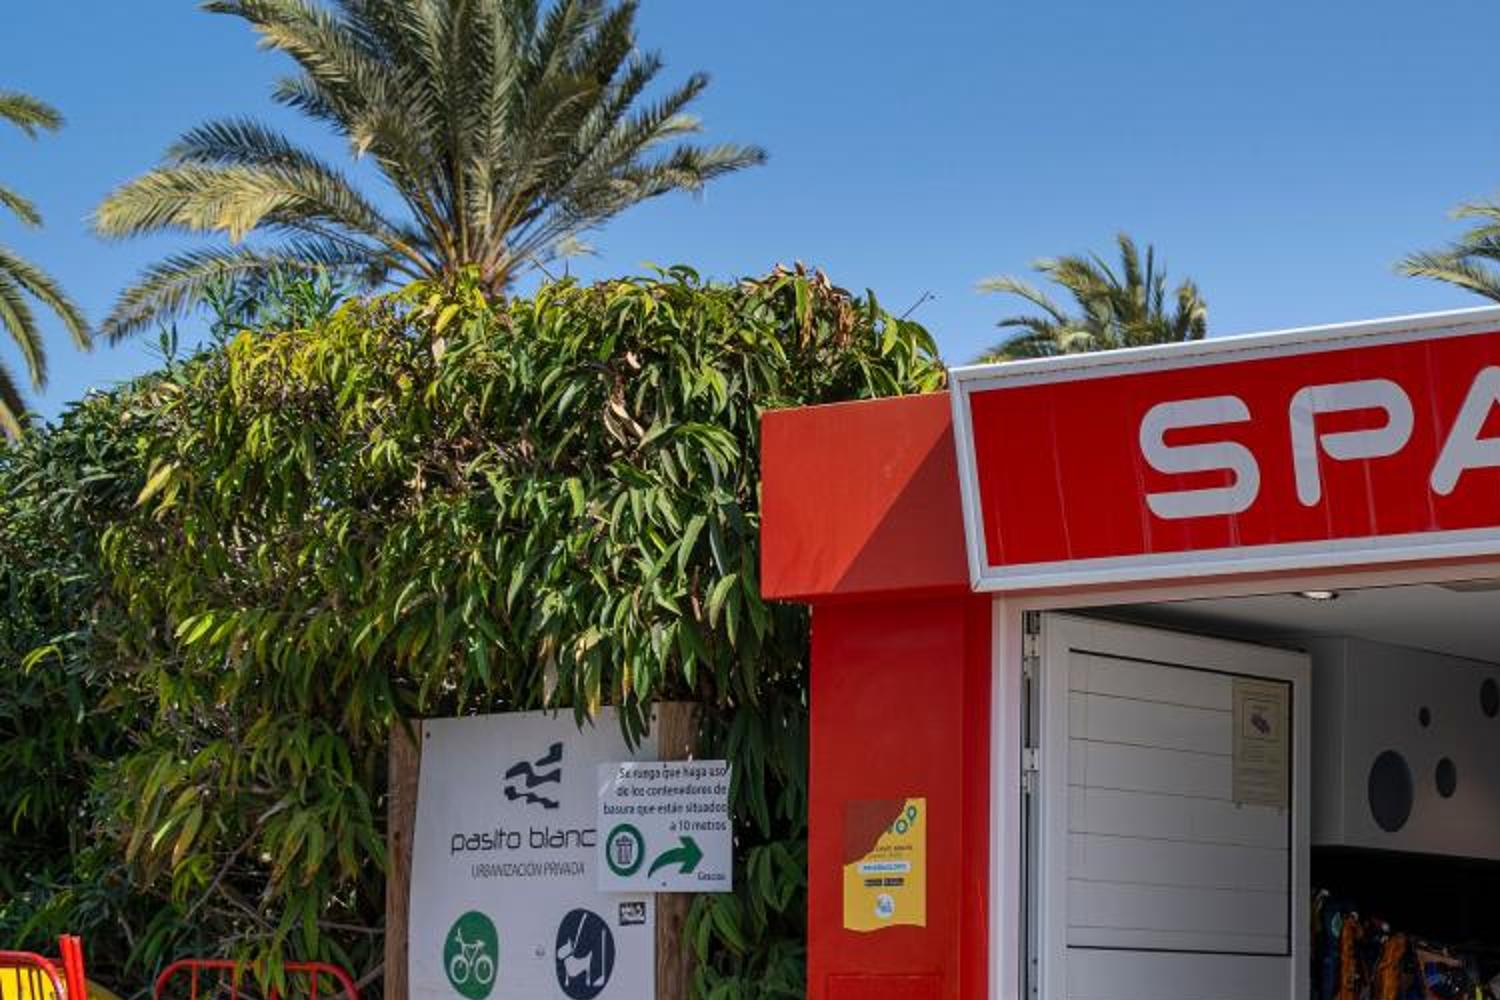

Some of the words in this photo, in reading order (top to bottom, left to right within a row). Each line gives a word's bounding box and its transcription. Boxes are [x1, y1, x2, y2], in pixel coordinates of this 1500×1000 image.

[620, 767, 631, 779] Se
[633, 768, 661, 780] ruega
[662, 769, 681, 781] que
[683, 767, 707, 780] haga
[709, 767, 727, 777] uso
[617, 785, 630, 797] de
[632, 784, 645, 797] los
[714, 783, 727, 795] de
[603, 803, 635, 815] basura
[637, 805, 656, 816] que
[685, 801, 728, 813] situados
[679, 821, 691, 832] 10
[692, 820, 728, 832] metros
[451, 827, 521, 856] pasito
[529, 826, 597, 849] blanc
